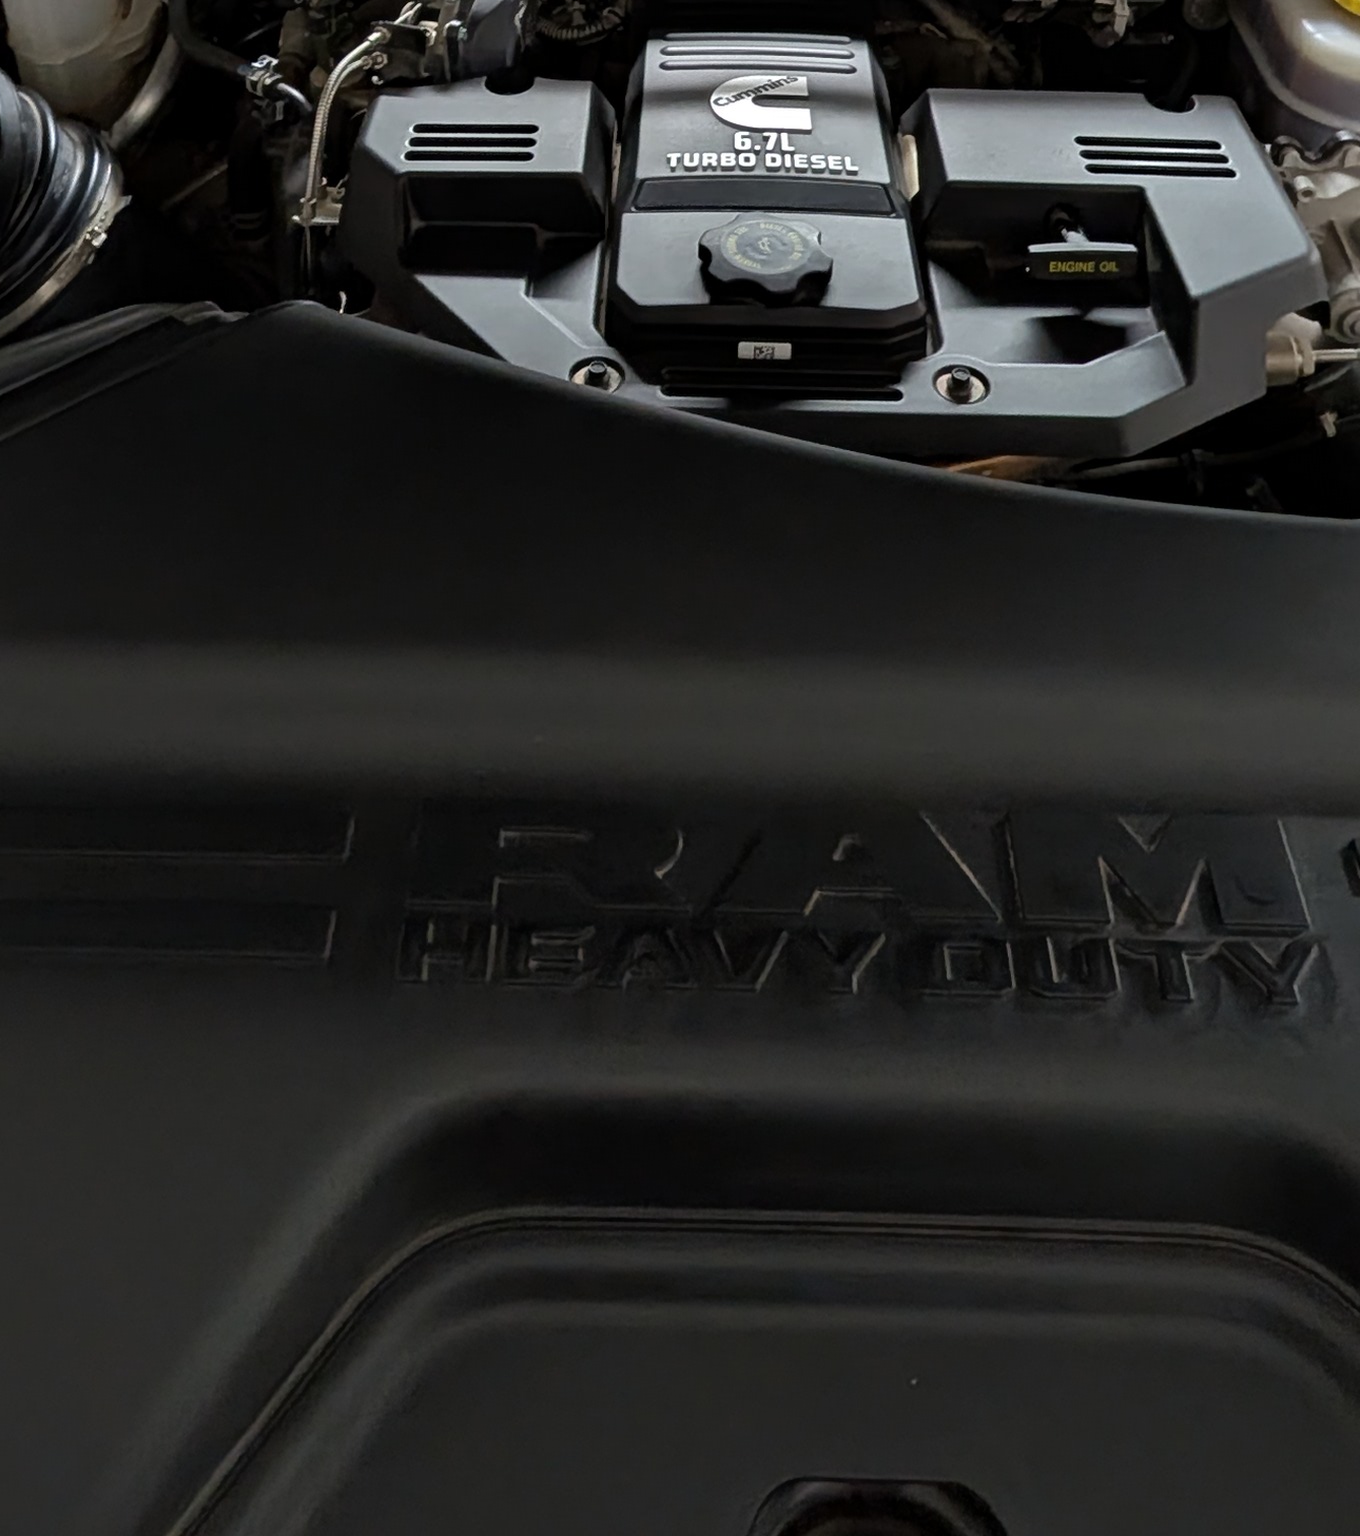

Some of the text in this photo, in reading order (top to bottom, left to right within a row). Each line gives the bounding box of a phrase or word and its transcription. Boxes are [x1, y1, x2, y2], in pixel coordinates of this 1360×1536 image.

[711, 75, 799, 107] Cummins
[733, 131, 795, 152] 6.7L
[666, 152, 859, 172] TURBO DIESEL
[1049, 260, 1120, 273] ENGINE OIL
[406, 811, 1312, 932] RAM
[398, 917, 1326, 1007] HEAVY DUTY
